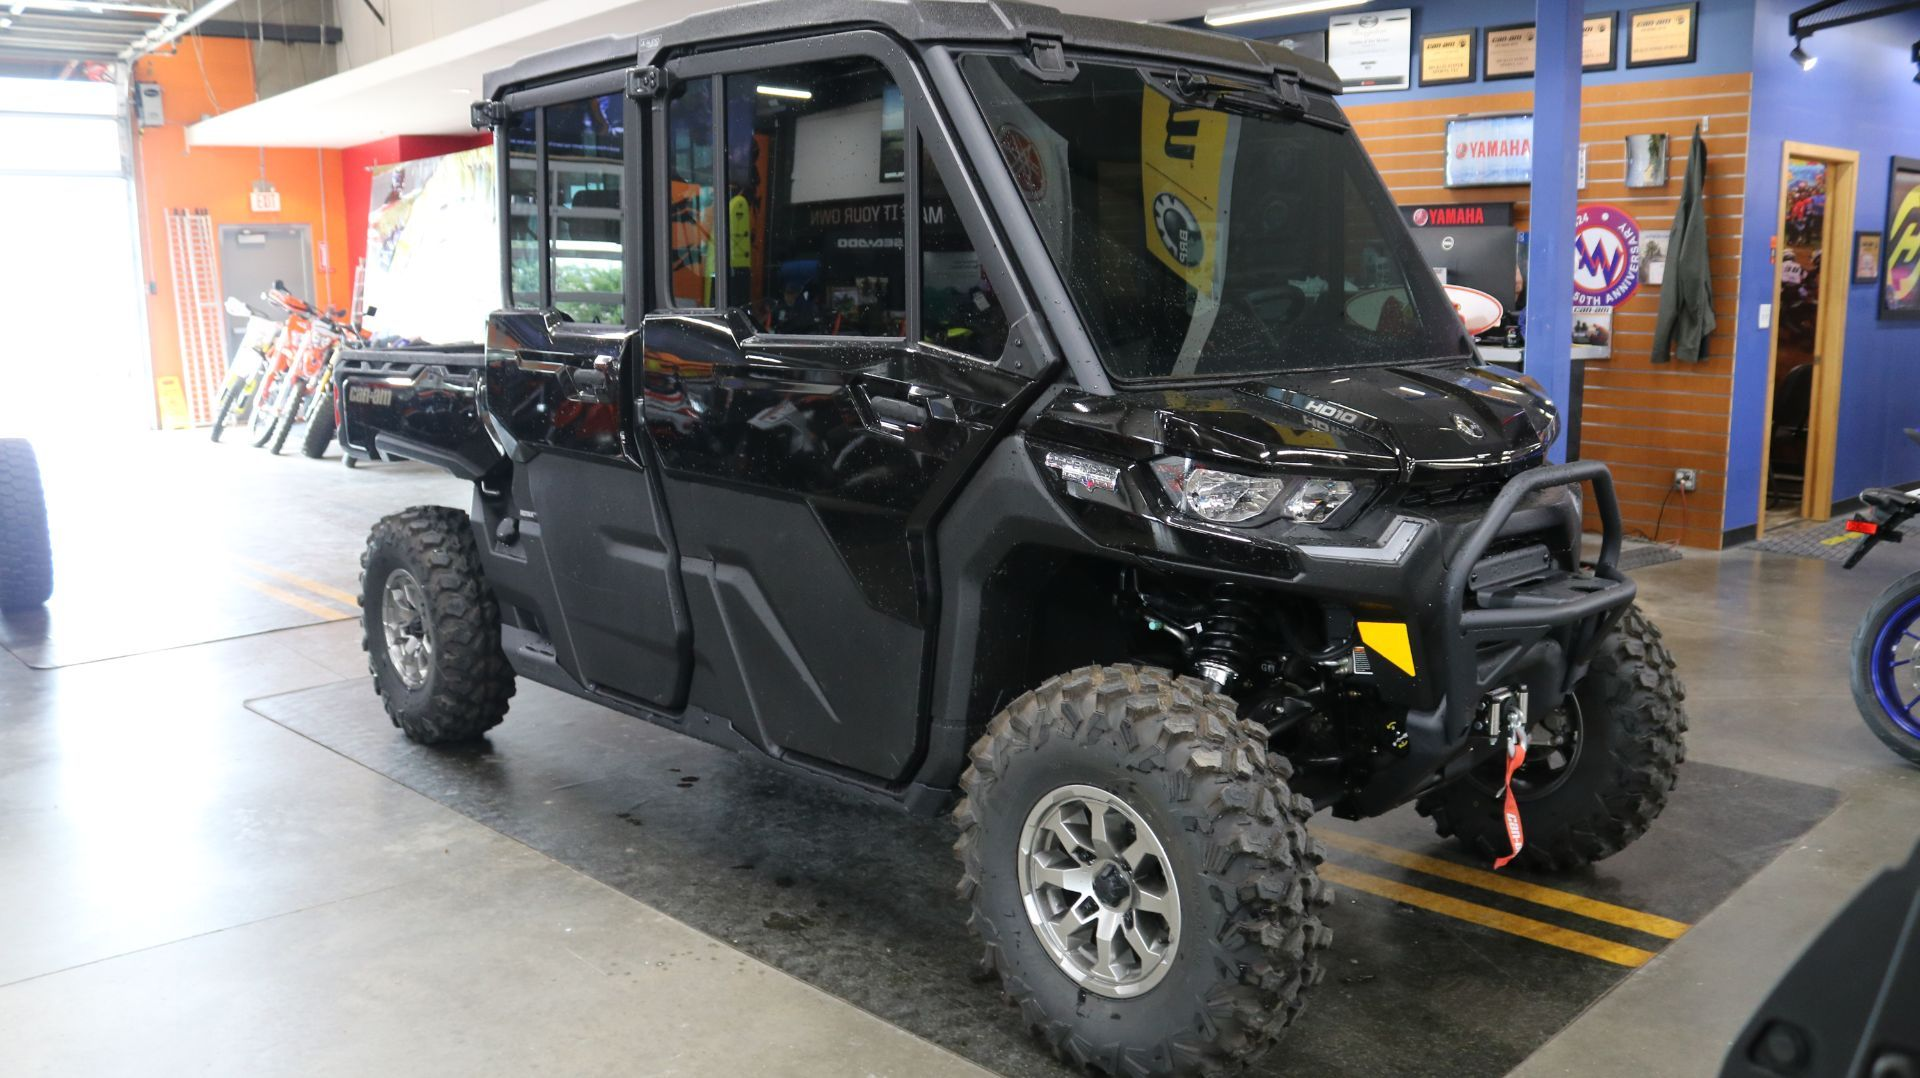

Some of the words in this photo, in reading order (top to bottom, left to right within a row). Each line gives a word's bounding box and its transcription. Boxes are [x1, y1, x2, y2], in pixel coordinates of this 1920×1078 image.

[1470, 138, 1531, 158] YAMAHA
[1429, 207, 1485, 224] YAMAHA
[1573, 291, 1601, 305] 50TH
[1605, 222, 1640, 304] ANNIVERSARY
[1305, 400, 1358, 424] HD10
